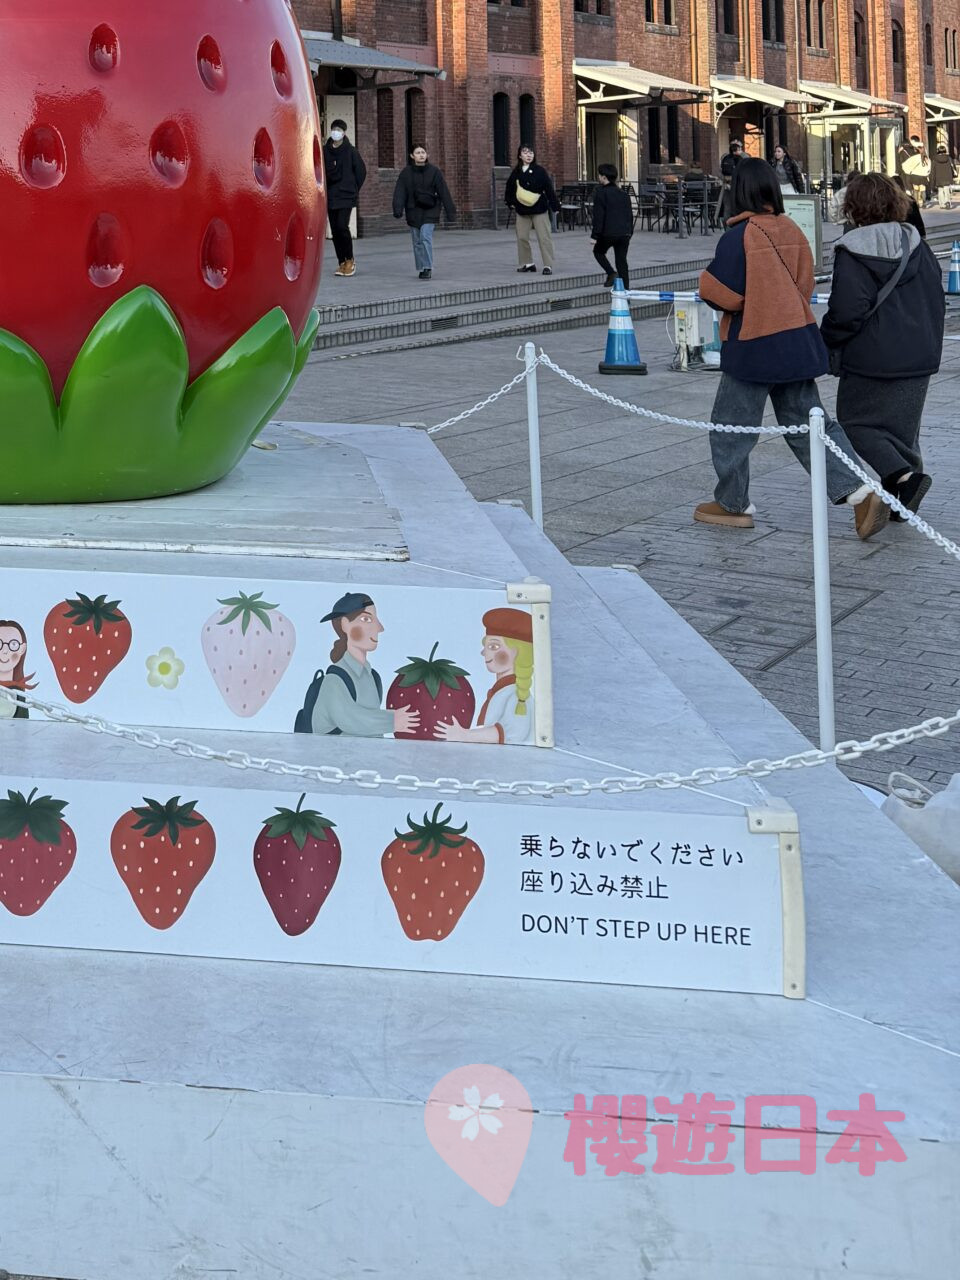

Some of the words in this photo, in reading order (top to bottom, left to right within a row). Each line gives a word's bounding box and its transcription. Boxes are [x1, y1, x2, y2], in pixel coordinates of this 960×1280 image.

[520, 834, 744, 867] 乗らないでください
[520, 869, 669, 899] 座り込み禁止
[521, 913, 589, 936] DON'T
[595, 918, 650, 939] STEP
[657, 922, 687, 942] UP
[694, 924, 752, 946] HERE
